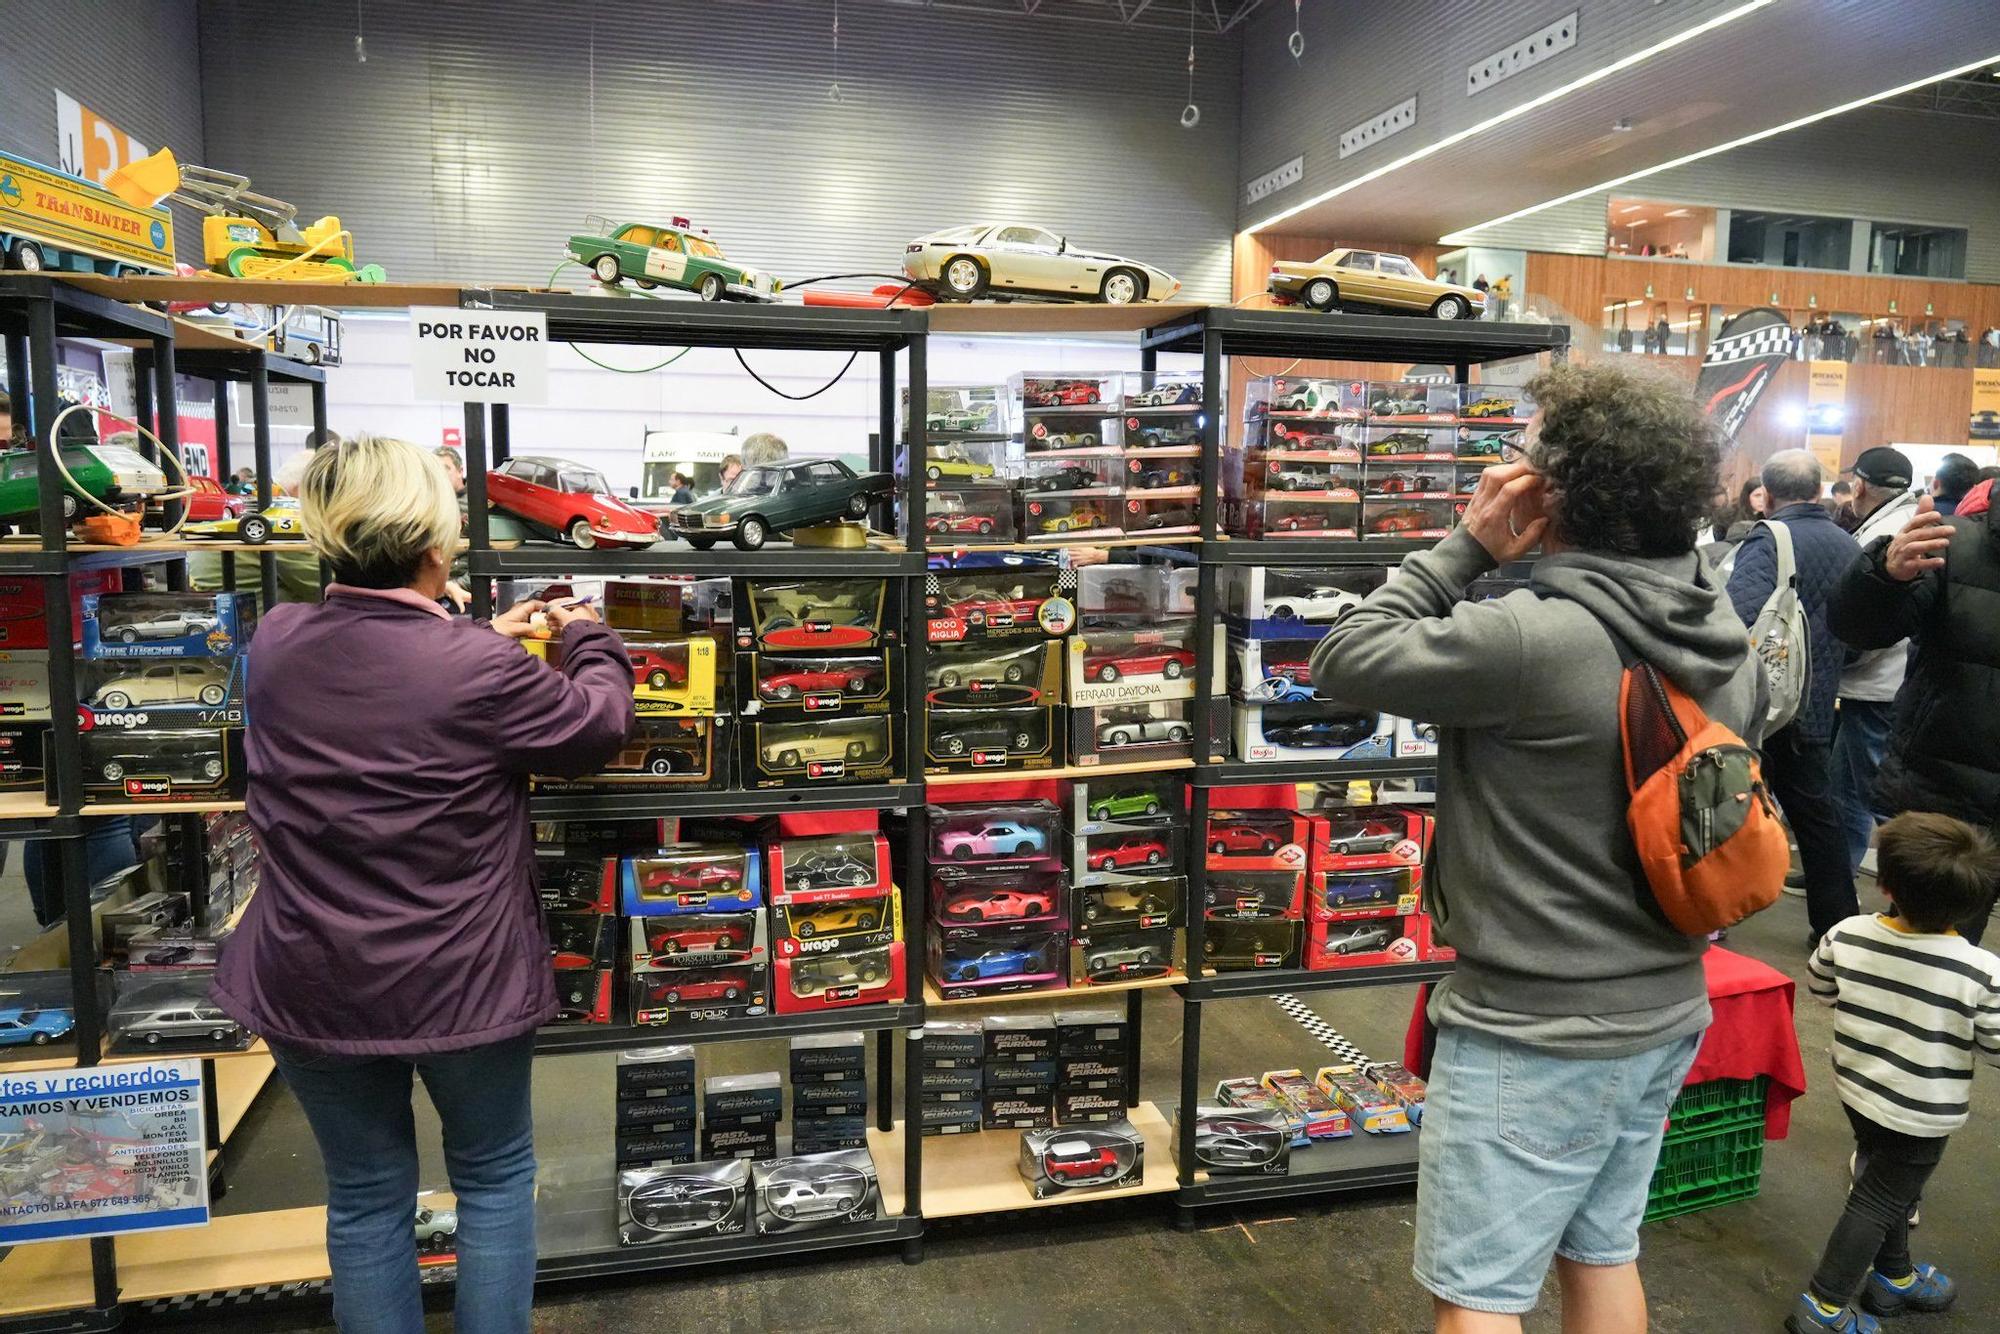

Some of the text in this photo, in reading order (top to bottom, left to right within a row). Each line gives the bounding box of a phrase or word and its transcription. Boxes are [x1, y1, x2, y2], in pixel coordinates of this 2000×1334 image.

[35, 191, 142, 237] TRANSINTER
[418, 322, 539, 342] POR FAVOR
[464, 347, 496, 363] NO
[446, 370, 516, 388] TOCAR
[280, 518, 293, 530] 3
[931, 621, 957, 629] 1000
[930, 630, 960, 639] MIGLIA
[98, 645, 185, 657] TIME MACHINE
[1075, 684, 1161, 702] FERRARI DAYTONA
[198, 710, 242, 722] 1/18
[783, 938, 839, 954] burago
[672, 952, 729, 965] PORSCHE 911
[996, 1039, 1048, 1050] FURIOUS
[1069, 1066, 1119, 1078] FURIOUS
[66, 1066, 181, 1093] recuerdos
[66, 1098, 81, 1111] Y
[86, 1088, 190, 1110] VENDEMOS
[1070, 1100, 1120, 1111] FURIOUS
[154, 1109, 187, 1118] ORBEA
[995, 1106, 1046, 1117] FURIOUS
[160, 1123, 187, 1132] G.A.C.
[142, 1130, 187, 1140] MONTESA
[713, 1134, 767, 1148] FURIOUS
[134, 1157, 189, 1168] MOLINILLOS
[122, 1163, 190, 1176] DISCOS VINILO
[56, 1199, 87, 1211] RAFA
[90, 1198, 109, 1208] 672
[111, 1196, 129, 1206] 649
[848, 1209, 876, 1221] Silver
[715, 1220, 745, 1234] Silver
